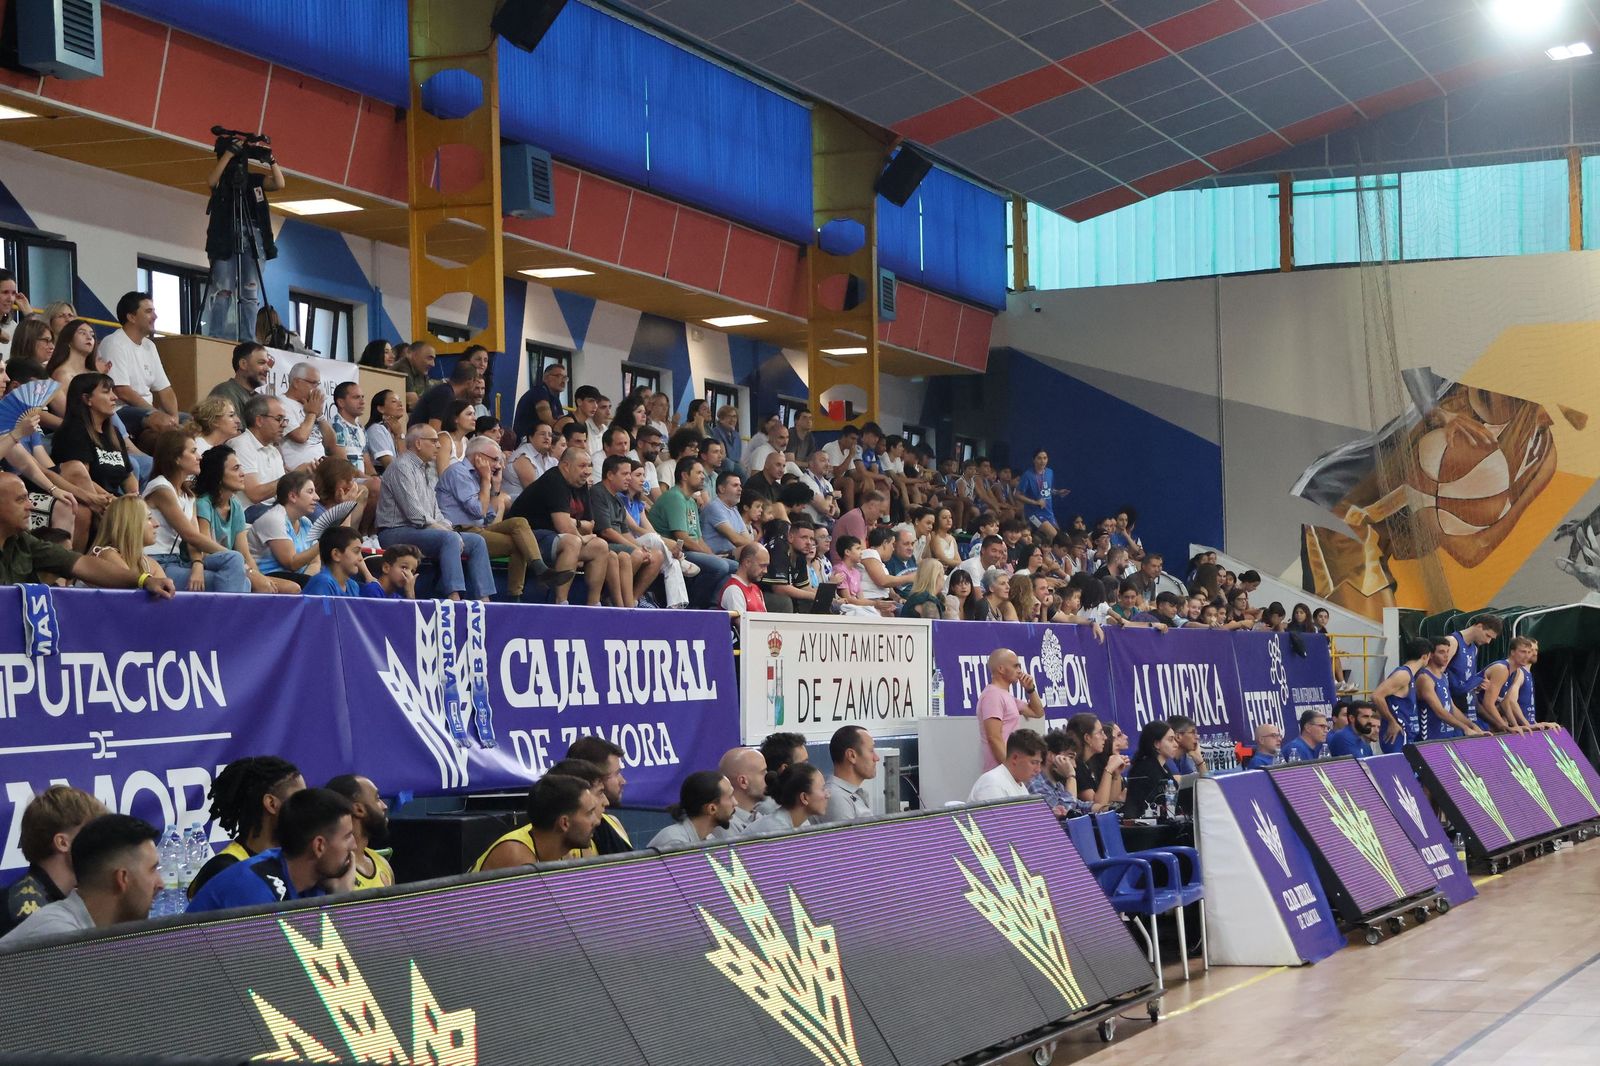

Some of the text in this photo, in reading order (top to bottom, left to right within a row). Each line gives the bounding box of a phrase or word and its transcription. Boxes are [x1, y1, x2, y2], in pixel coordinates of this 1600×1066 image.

[798, 632, 915, 663] AYUNTAMIENTO
[500, 637, 718, 714] CAJA RURAL
[798, 676, 914, 723] DE ZAMORA
[508, 722, 680, 775] DE ZMORA
